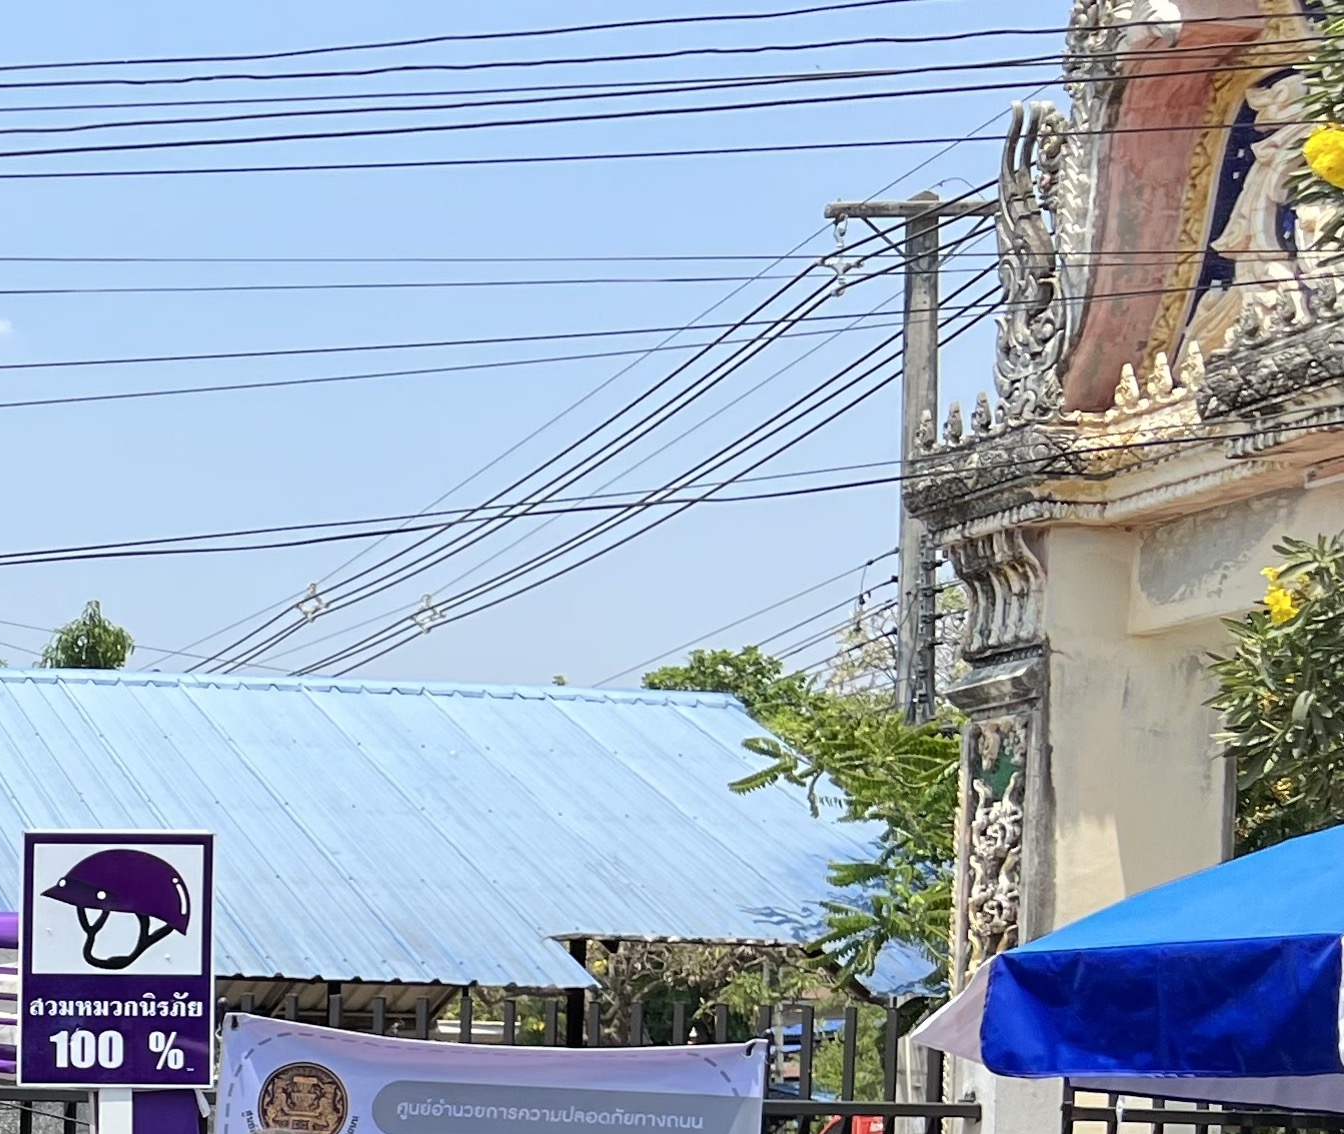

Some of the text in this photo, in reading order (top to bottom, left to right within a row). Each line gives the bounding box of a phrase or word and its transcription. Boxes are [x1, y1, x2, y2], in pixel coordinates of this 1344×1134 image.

[29, 992, 203, 1018] สวมหมวกนิรภัย
[49, 1029, 185, 1070] 100 %
[396, 1099, 704, 1130] ศูนย์อำนวยการความปลอดภัยทางถนน
